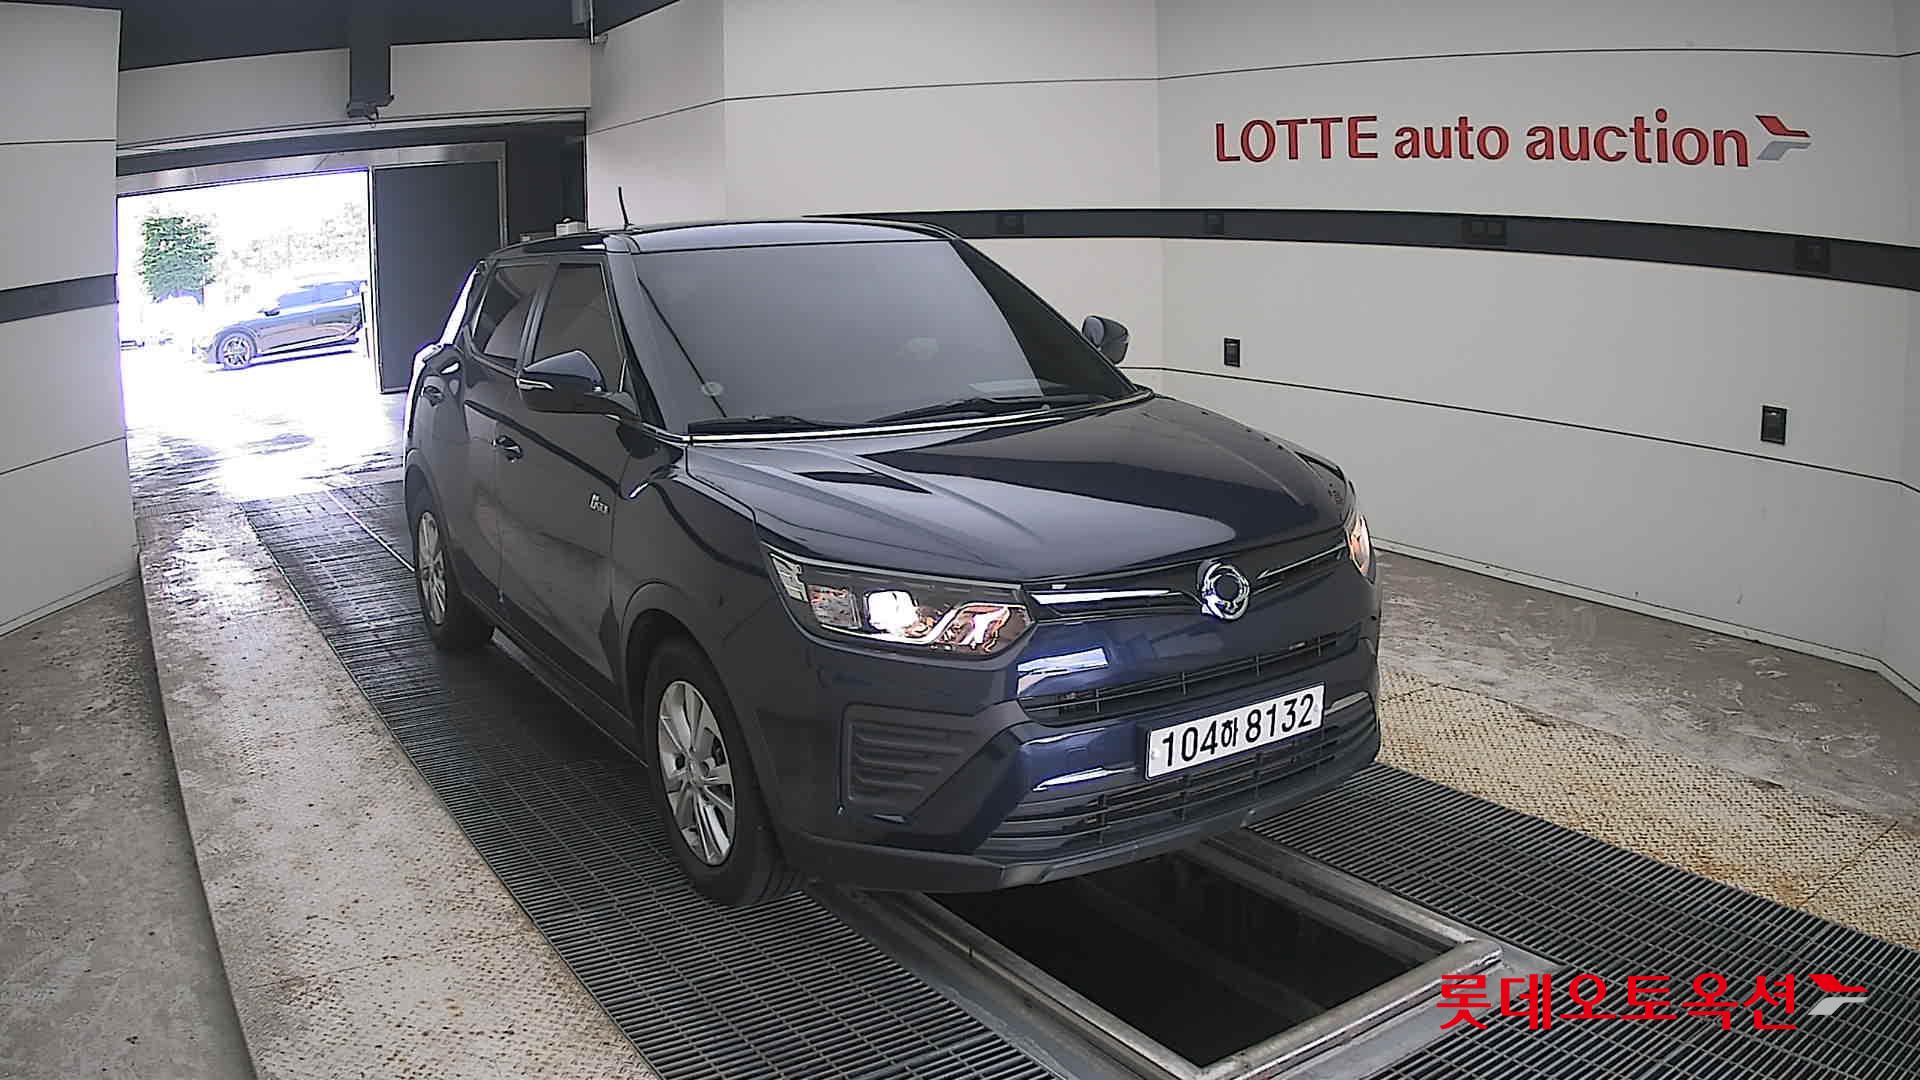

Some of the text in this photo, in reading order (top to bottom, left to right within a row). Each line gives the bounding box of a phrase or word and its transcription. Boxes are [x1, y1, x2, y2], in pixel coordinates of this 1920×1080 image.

[1214, 107, 1750, 168] LOTTE auto auction
